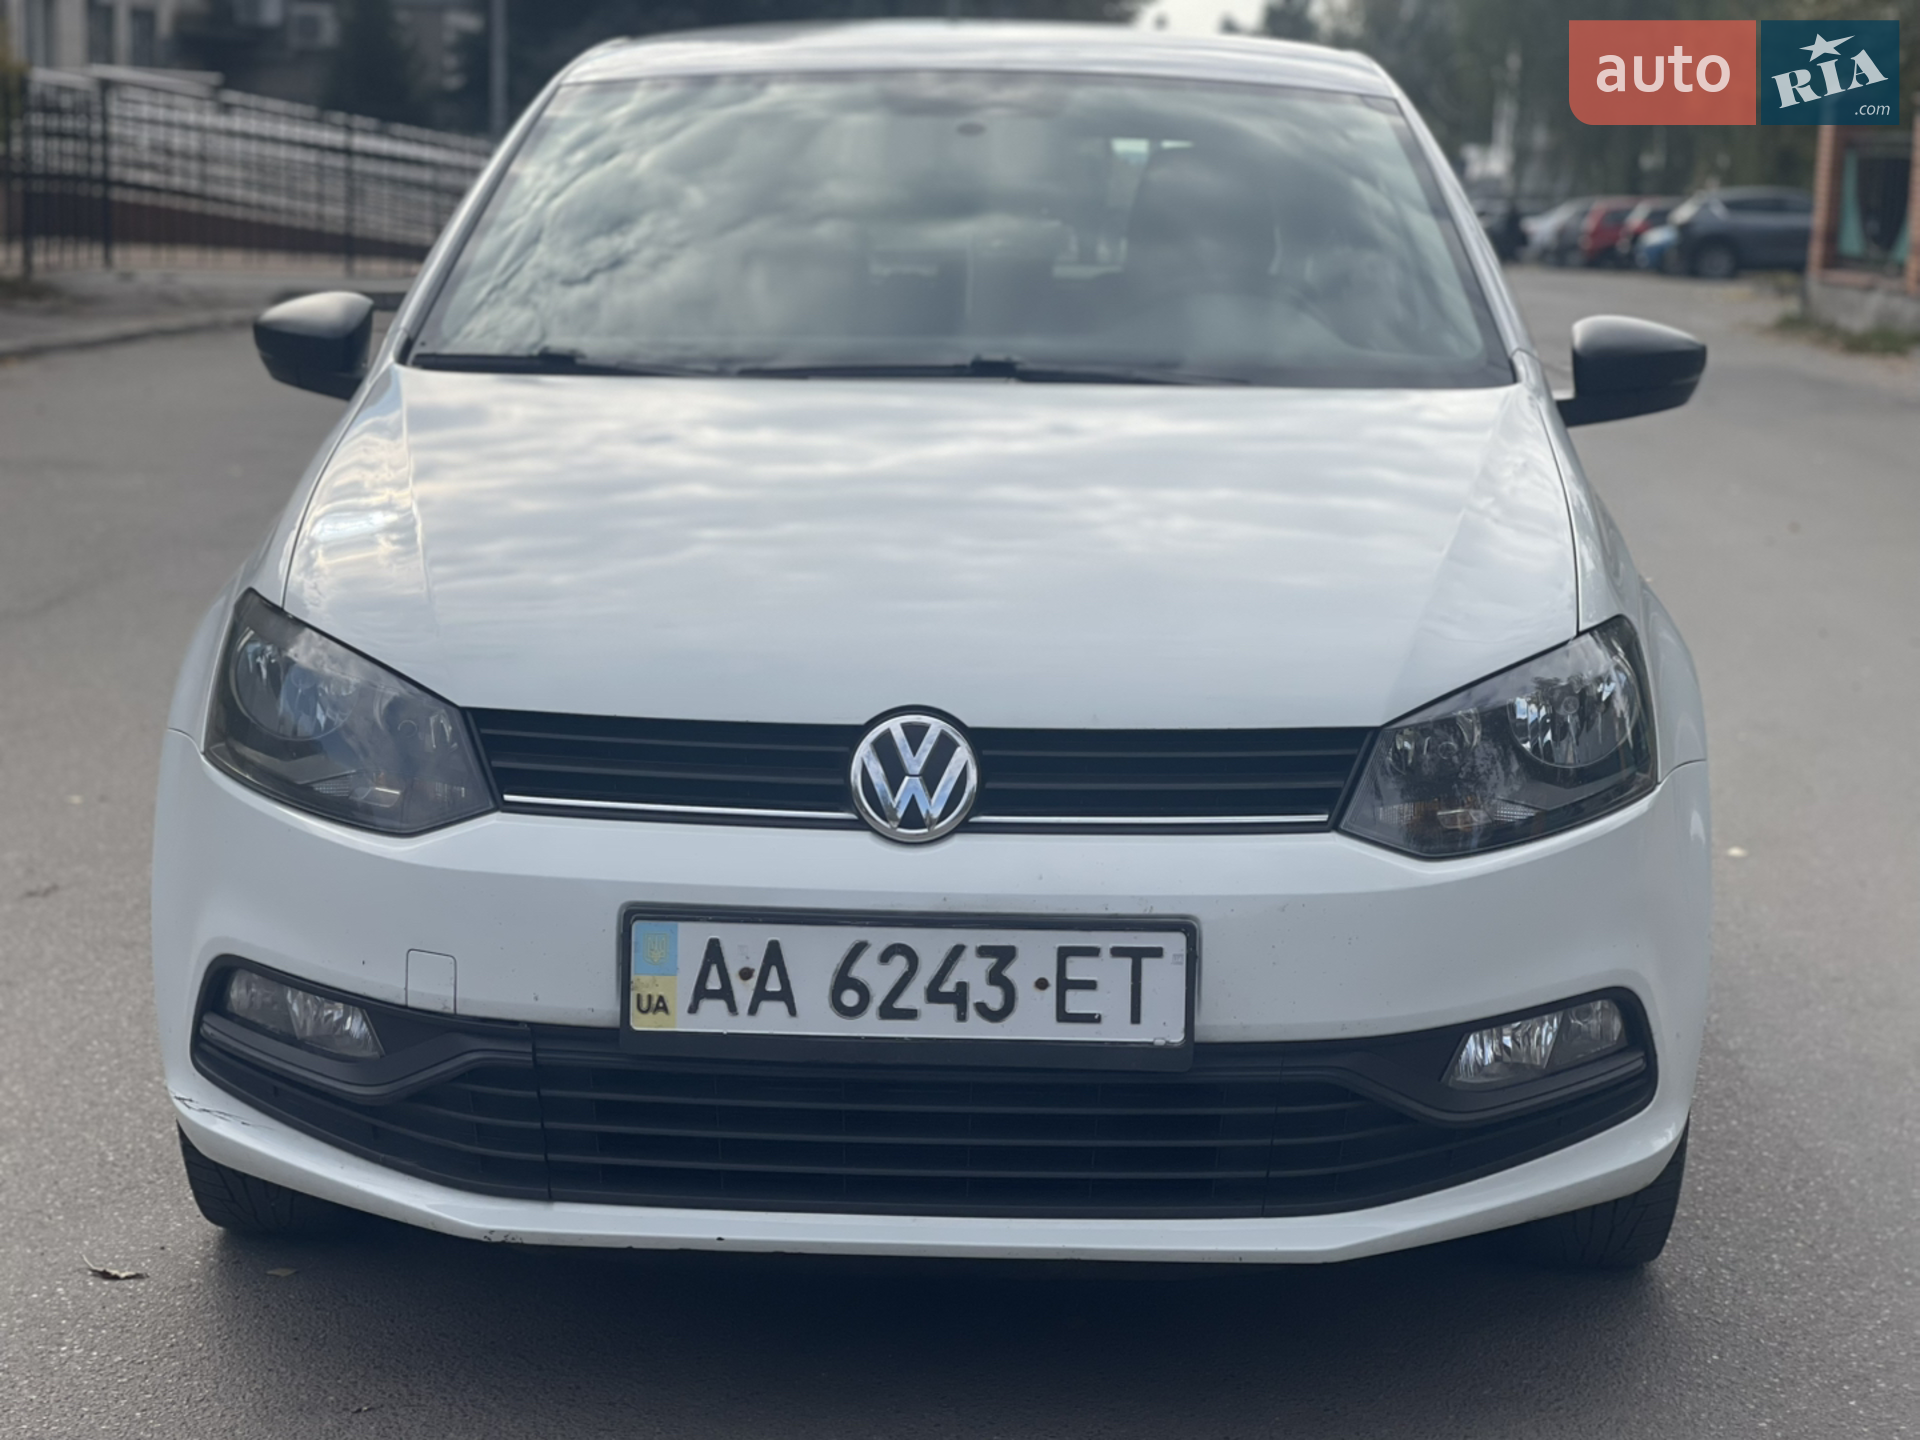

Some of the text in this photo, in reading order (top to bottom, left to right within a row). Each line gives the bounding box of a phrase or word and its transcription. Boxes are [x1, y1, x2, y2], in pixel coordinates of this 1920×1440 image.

[635, 992, 671, 1016] UA
[687, 936, 1165, 1025] AA 6243 ET
